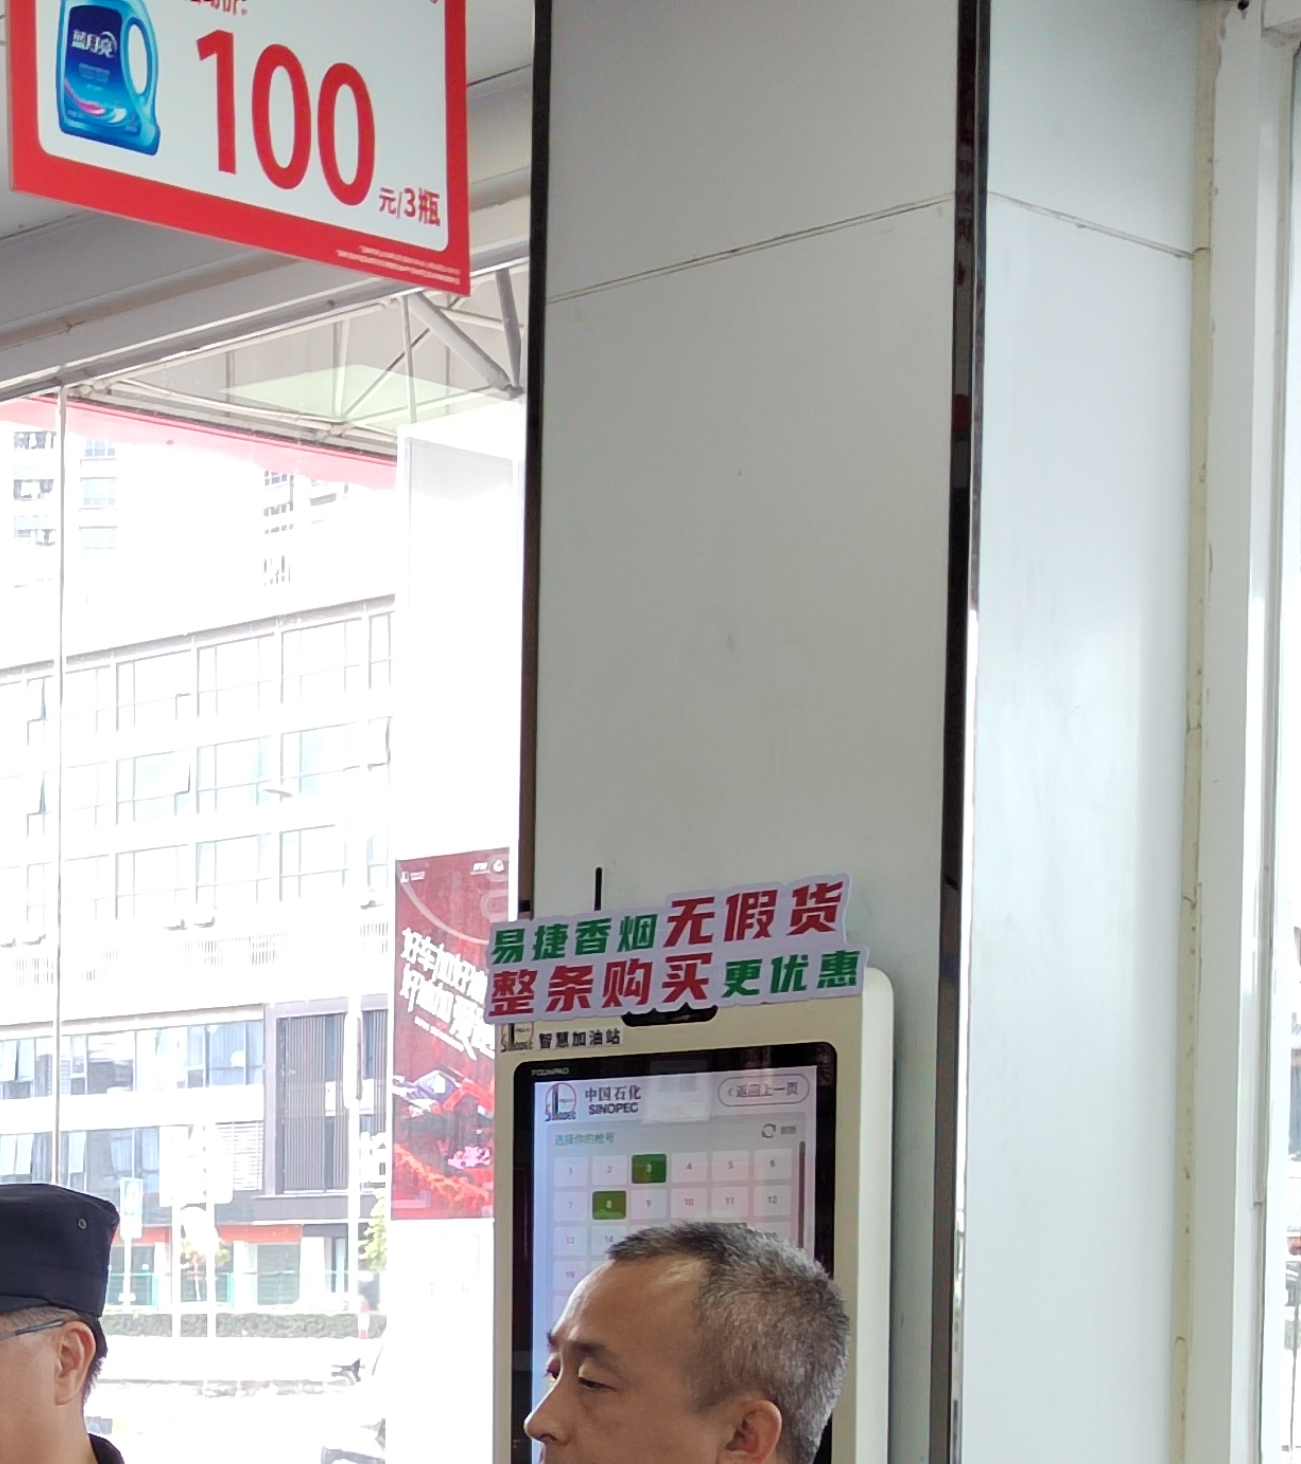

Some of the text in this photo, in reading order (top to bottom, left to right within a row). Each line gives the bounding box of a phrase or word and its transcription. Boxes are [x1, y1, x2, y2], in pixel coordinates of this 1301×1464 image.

[71, 28, 116, 58] 蓝月亮
[195, 29, 441, 227] 100 元/3瓶
[492, 881, 843, 965] 易捷香烟无假货
[488, 950, 861, 1017] 整条购买更优惠
[538, 1028, 621, 1049] 智慧加油站
[584, 1084, 642, 1103] 中国石化
[735, 1080, 799, 1098] 返回上一页
[588, 1102, 639, 1116] SINOPEC
